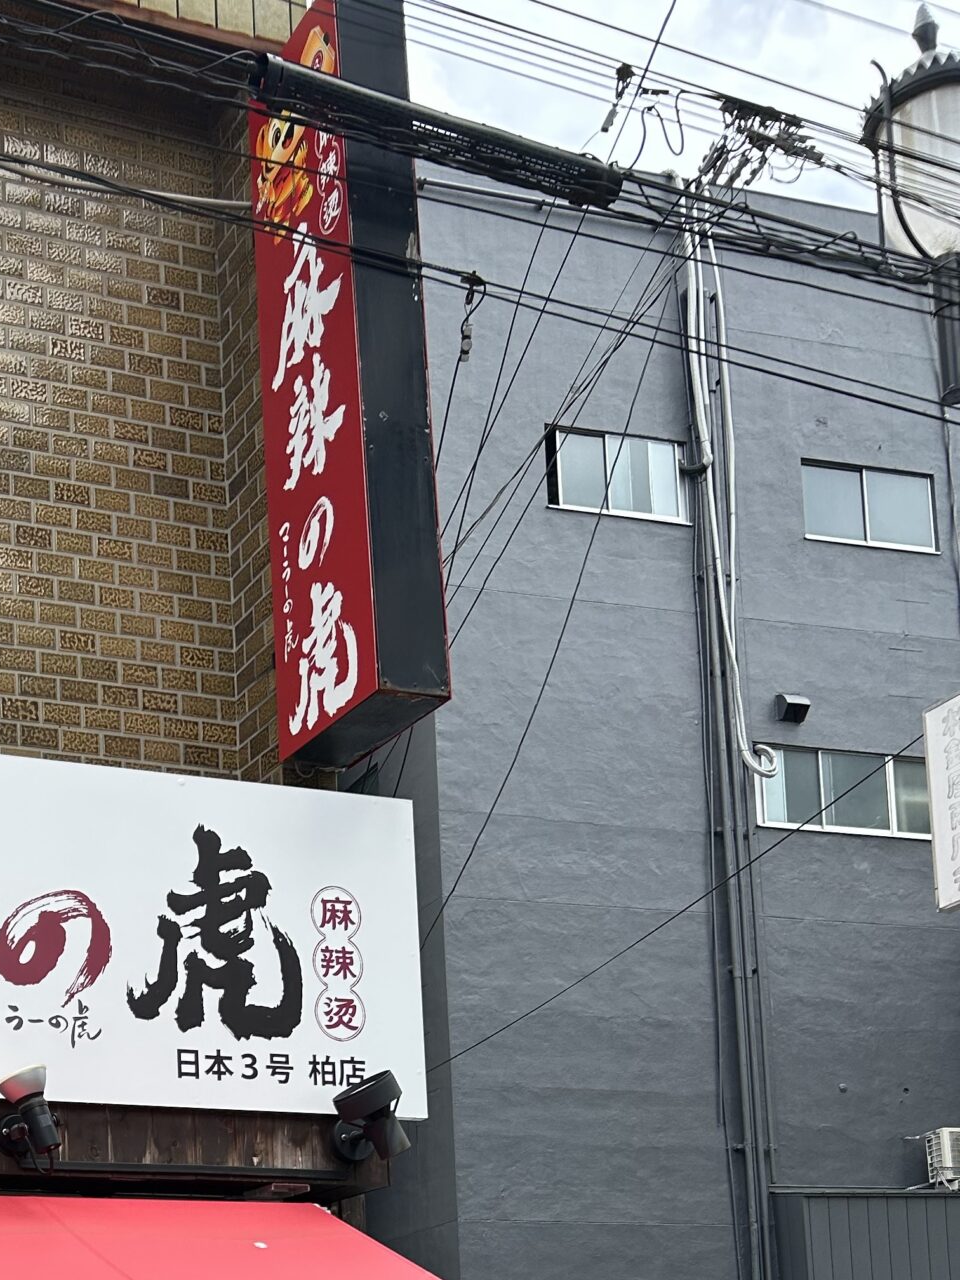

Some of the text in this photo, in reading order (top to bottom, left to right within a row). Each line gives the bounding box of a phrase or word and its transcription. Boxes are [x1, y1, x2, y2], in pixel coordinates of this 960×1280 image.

[319, 896, 360, 1032] 麻辣烫
[176, 1048, 367, 1088] 日本3号 柏店
